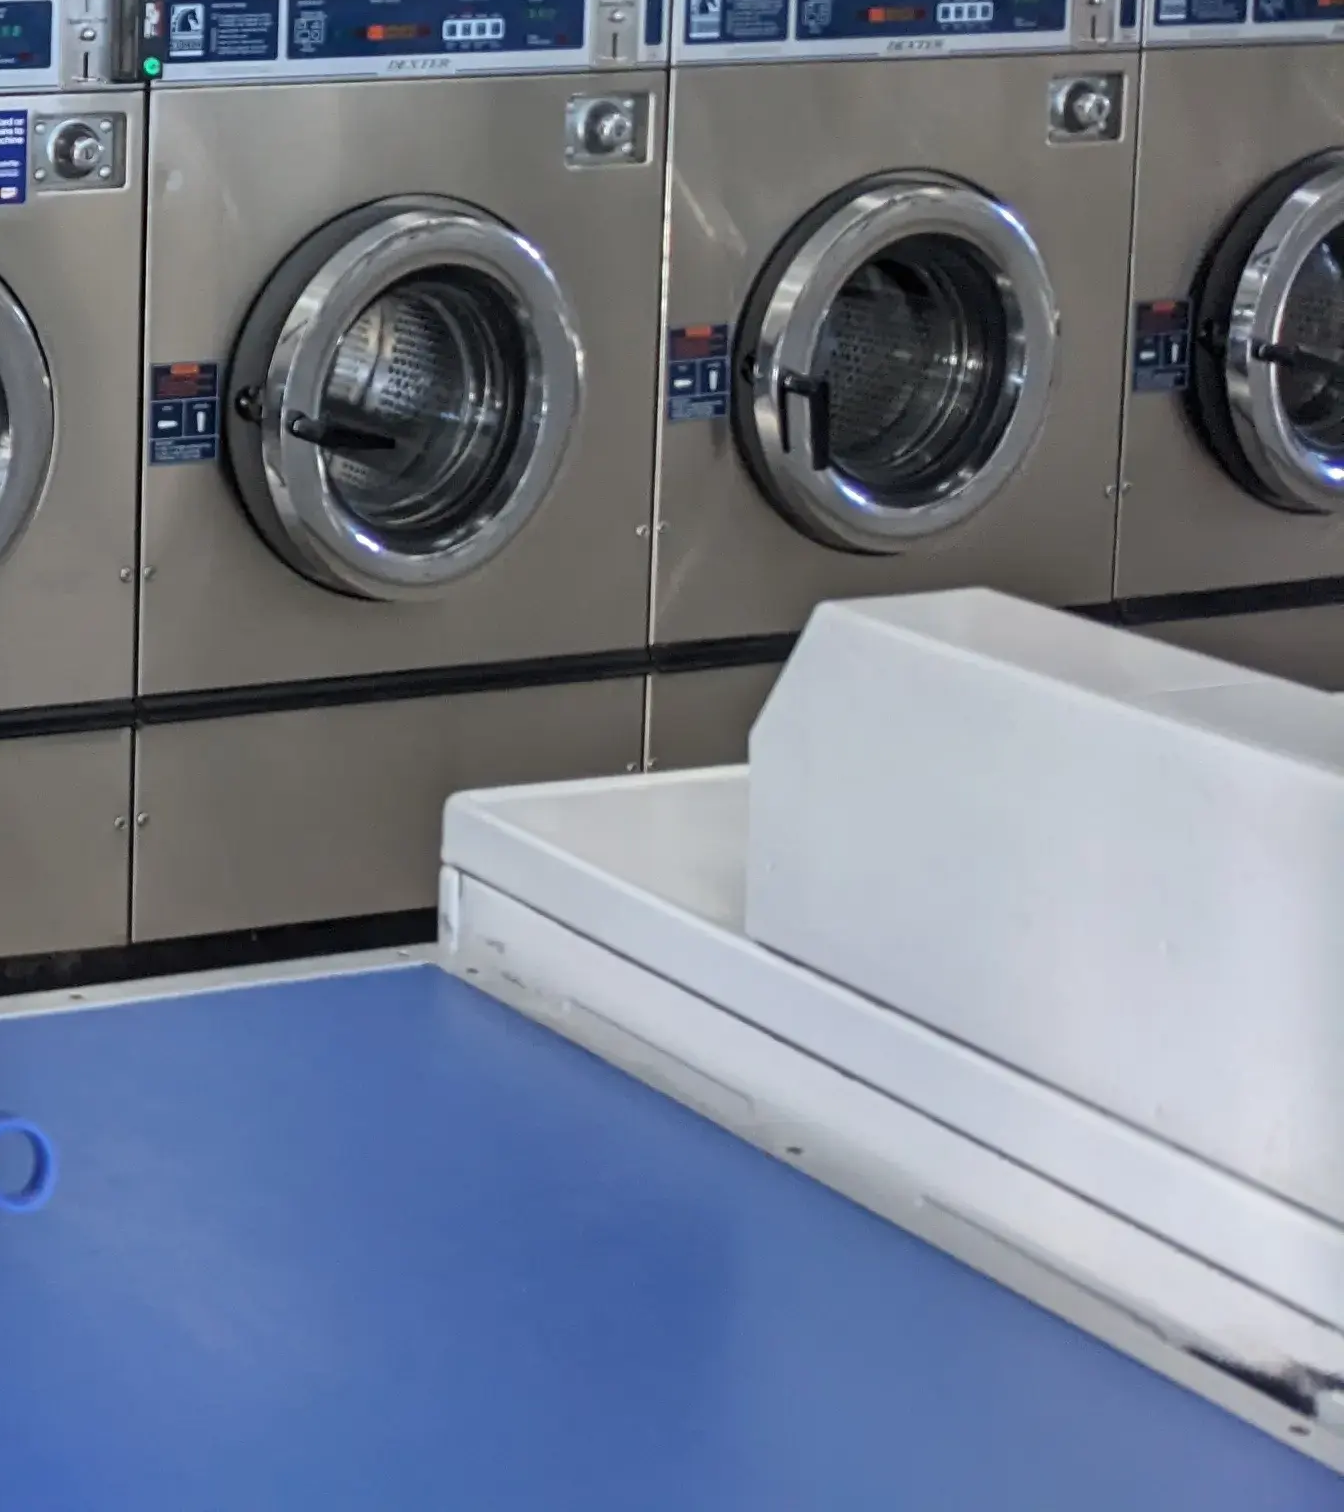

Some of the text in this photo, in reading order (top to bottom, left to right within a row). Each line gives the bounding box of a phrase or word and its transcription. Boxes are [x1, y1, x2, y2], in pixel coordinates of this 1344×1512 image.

[387, 58, 451, 71] DEXTER
[14, 118, 25, 126] or
[14, 127, 25, 135] to
